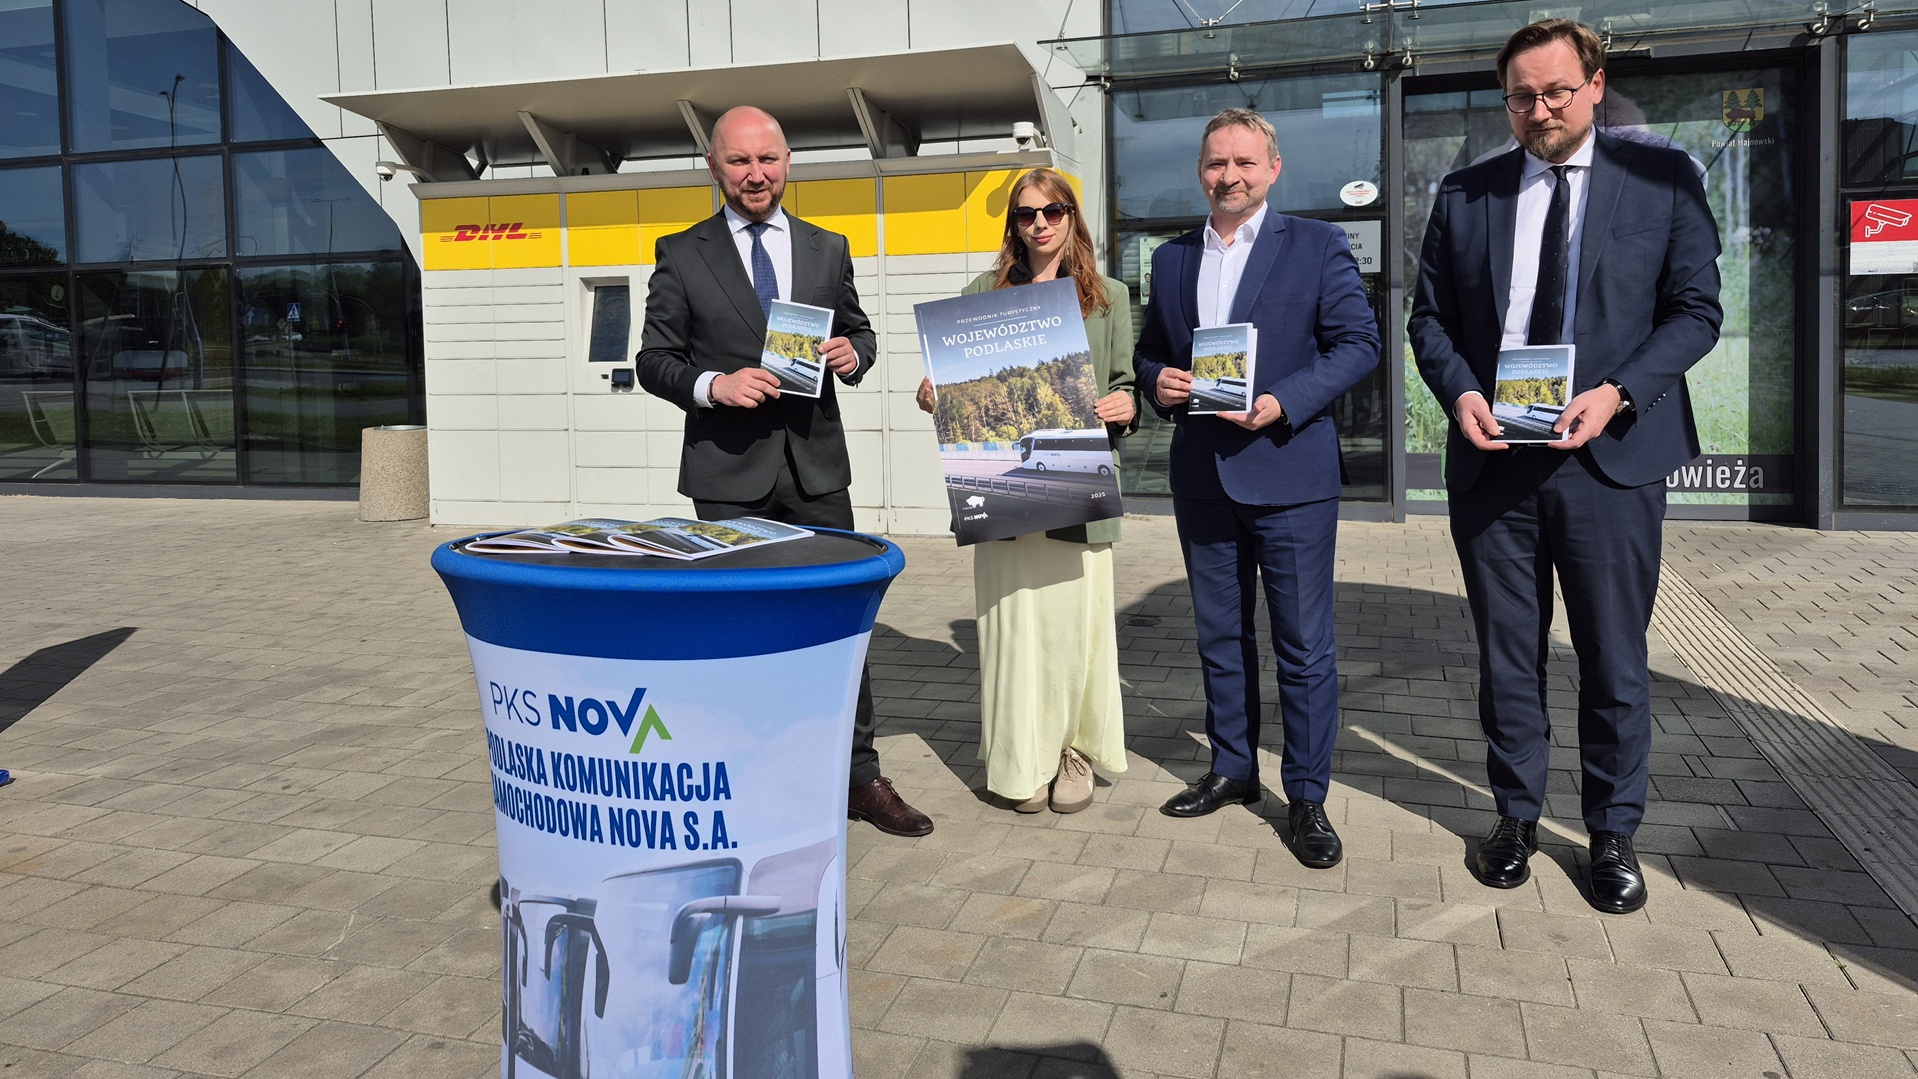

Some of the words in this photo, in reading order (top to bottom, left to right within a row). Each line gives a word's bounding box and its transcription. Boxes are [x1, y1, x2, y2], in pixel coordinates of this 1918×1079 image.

[1738, 137, 1775, 147] Hajnowski
[453, 222, 528, 241] DHL
[956, 312, 998, 325] PRZEWODNIK
[999, 305, 1042, 317] TURYSTYCZNY
[941, 315, 1063, 348] WOJEWÓDZTWO
[963, 333, 1048, 359] PODLASKIE
[1090, 491, 1106, 499] 2025
[489, 680, 542, 727] PKS
[547, 687, 673, 755] NOVA
[485, 726, 549, 787] PODLASKA
[550, 751, 732, 802] KOMUNIKACJA
[608, 806, 677, 850] NOVA
[682, 810, 738, 851] S.A.
